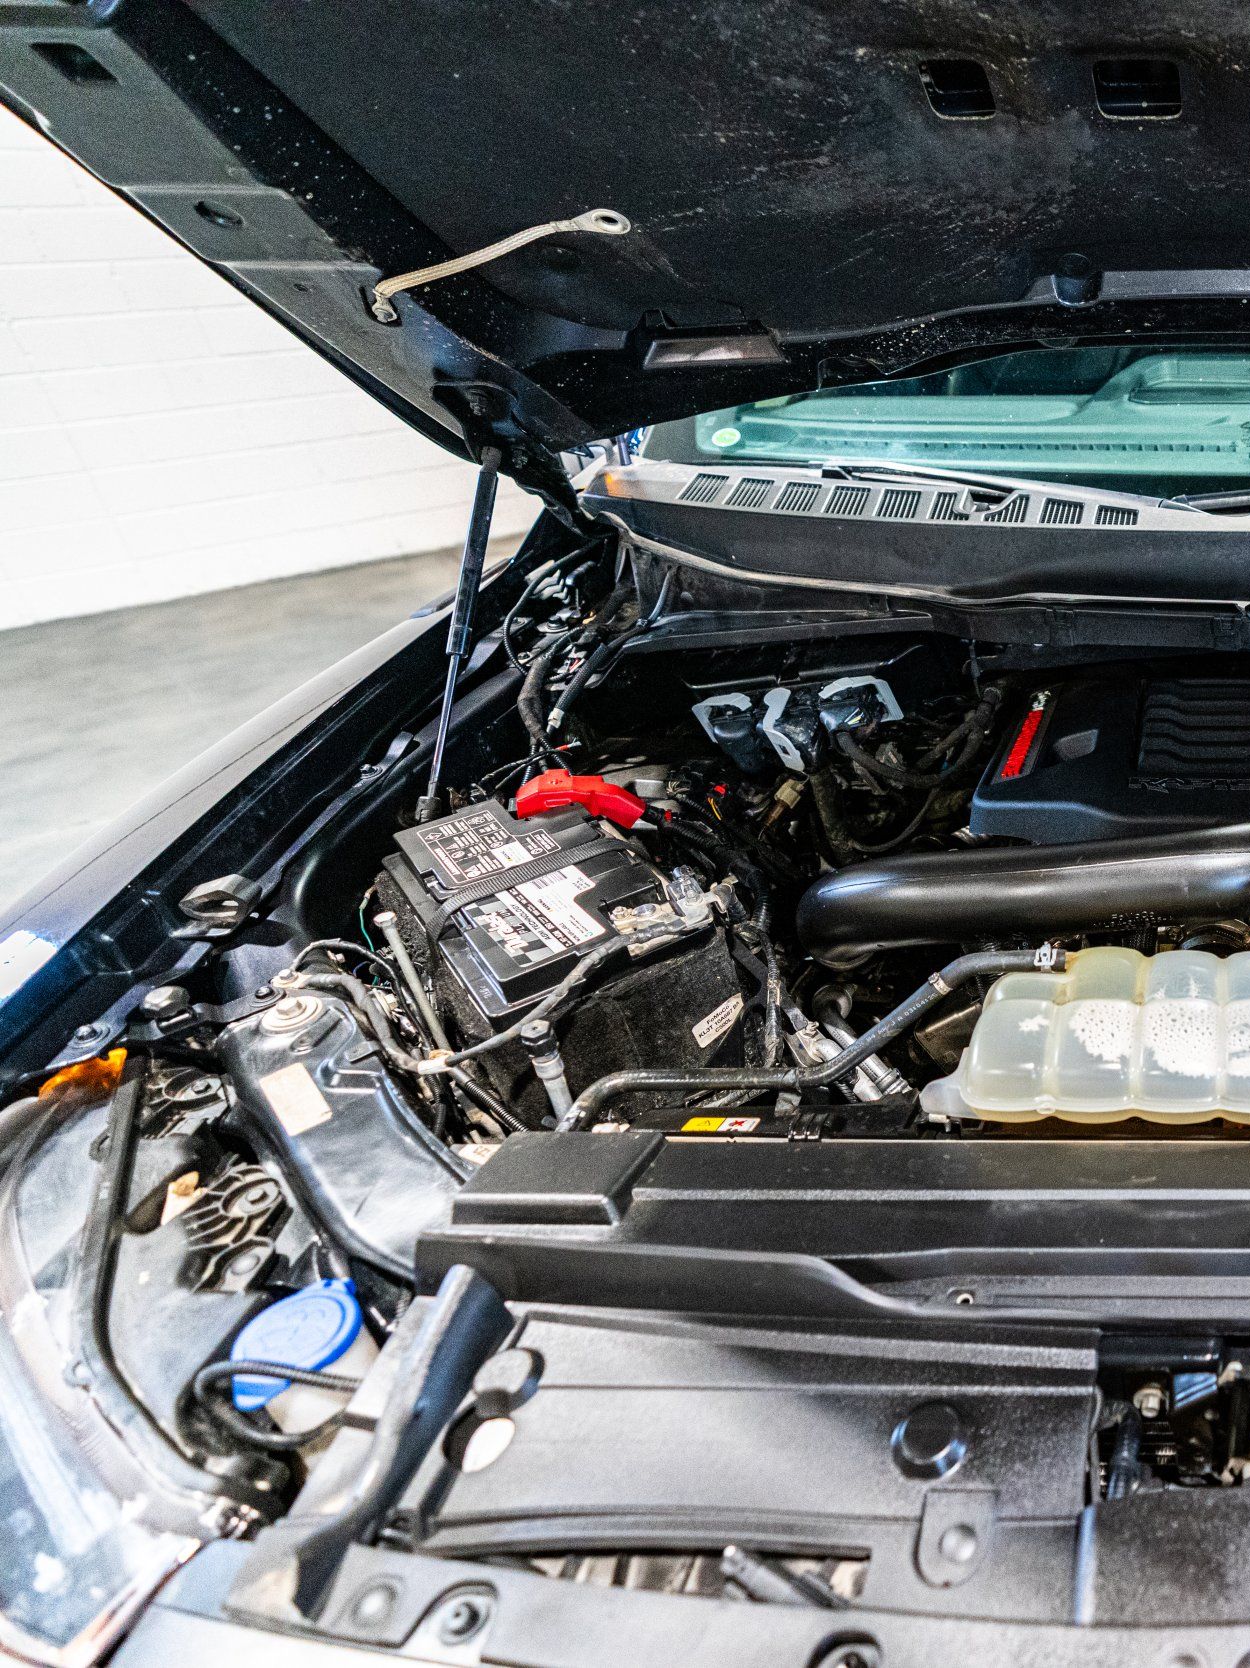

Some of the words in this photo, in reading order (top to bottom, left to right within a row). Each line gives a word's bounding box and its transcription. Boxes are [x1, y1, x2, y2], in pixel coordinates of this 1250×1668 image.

[511, 903, 541, 932] TECHNOLOGY
[537, 928, 552, 942] AGM
[707, 1006, 729, 1024] FoMoCo
